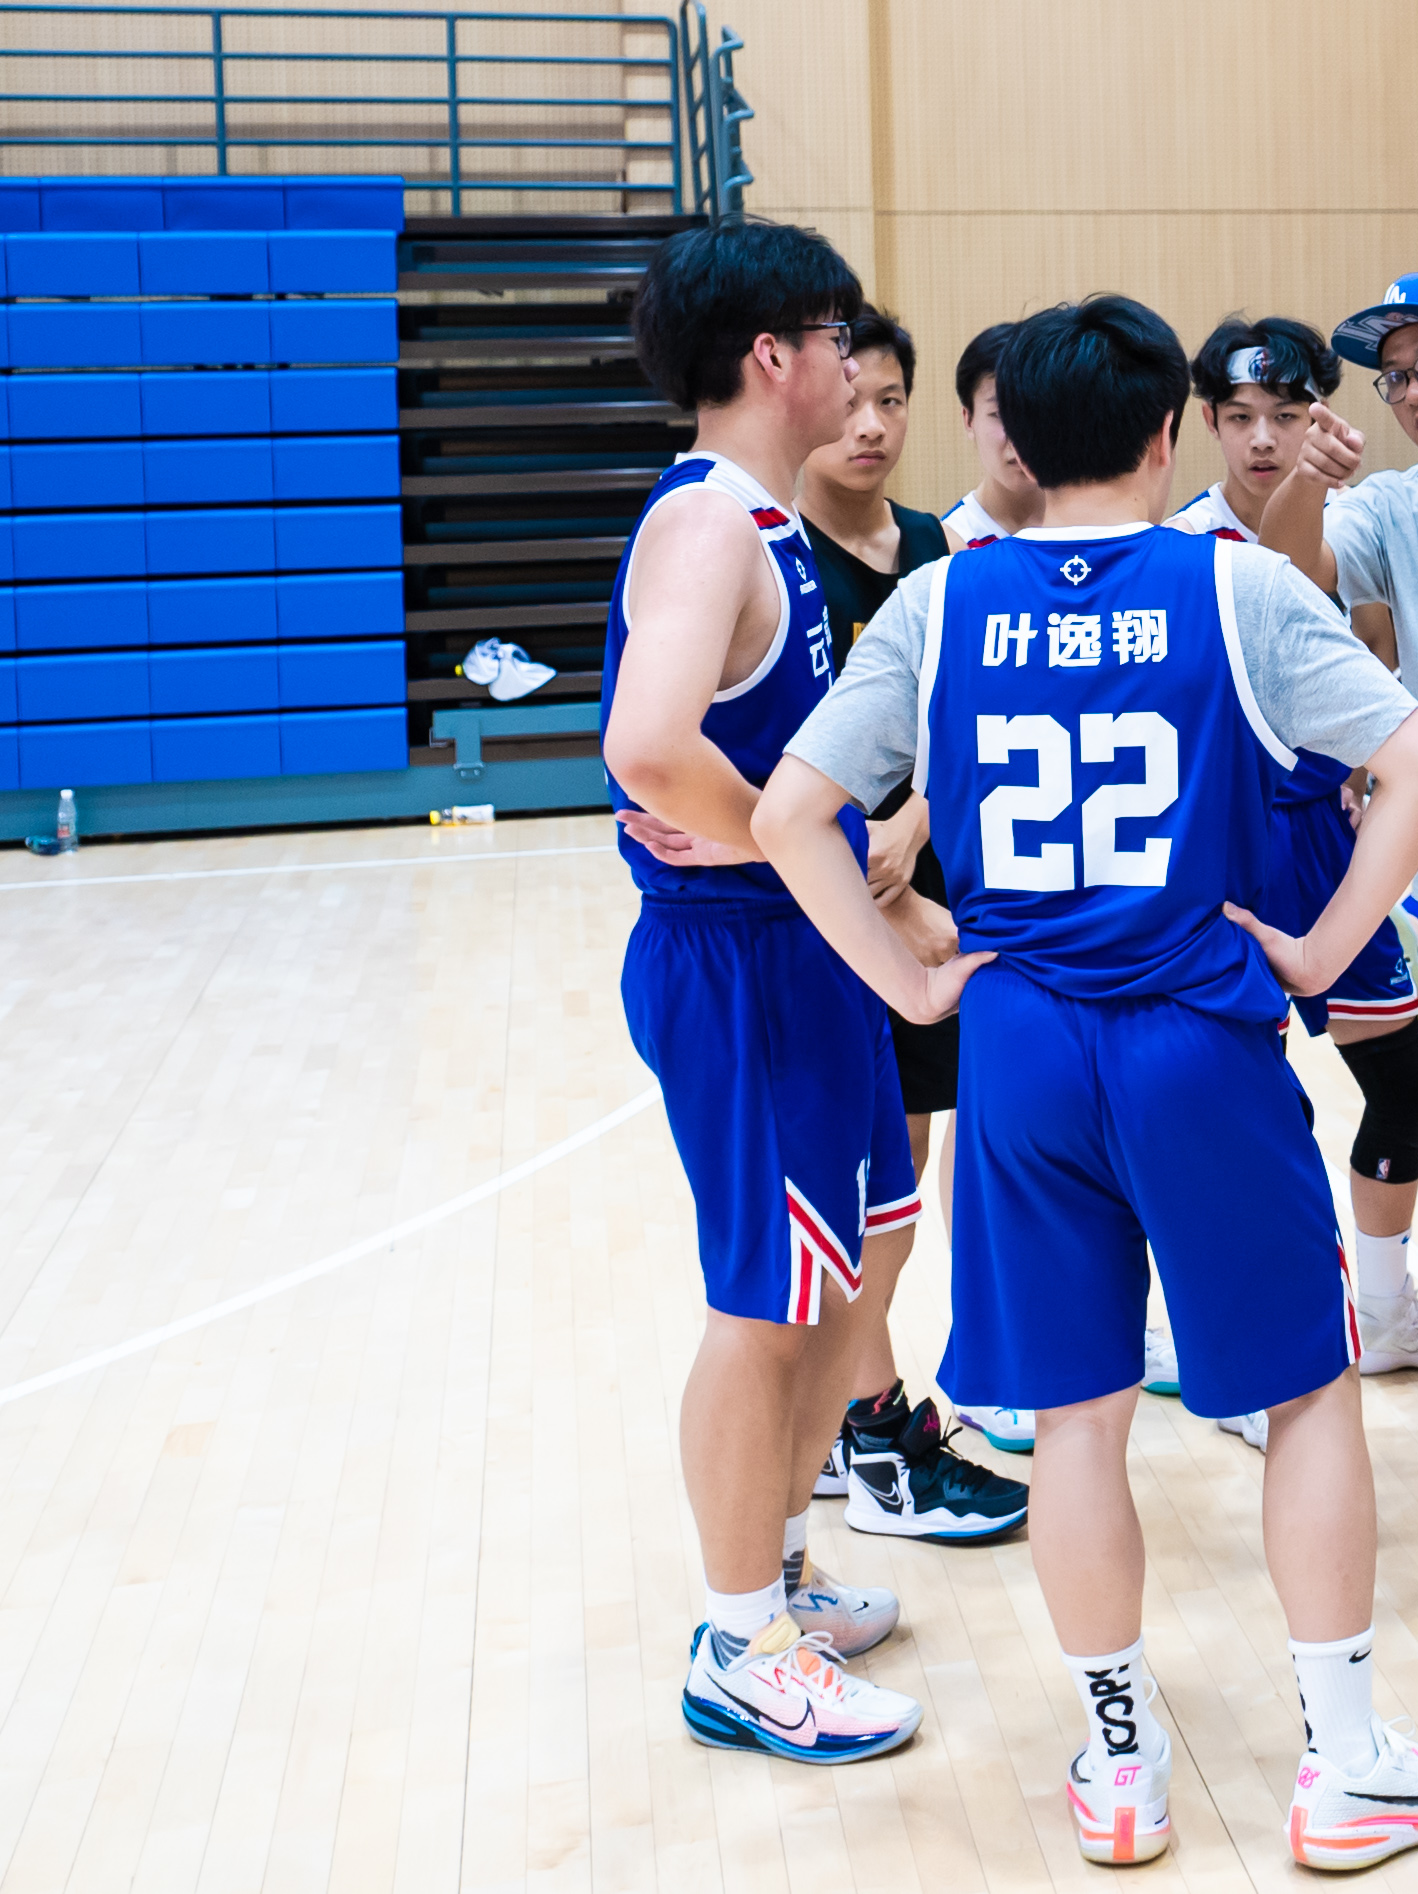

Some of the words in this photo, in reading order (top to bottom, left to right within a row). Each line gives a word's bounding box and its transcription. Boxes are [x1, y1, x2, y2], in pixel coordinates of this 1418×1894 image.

[982, 609, 1168, 668] 叶逸翔
[976, 711, 1179, 893] 22
[1114, 1765, 1142, 1786] GT
